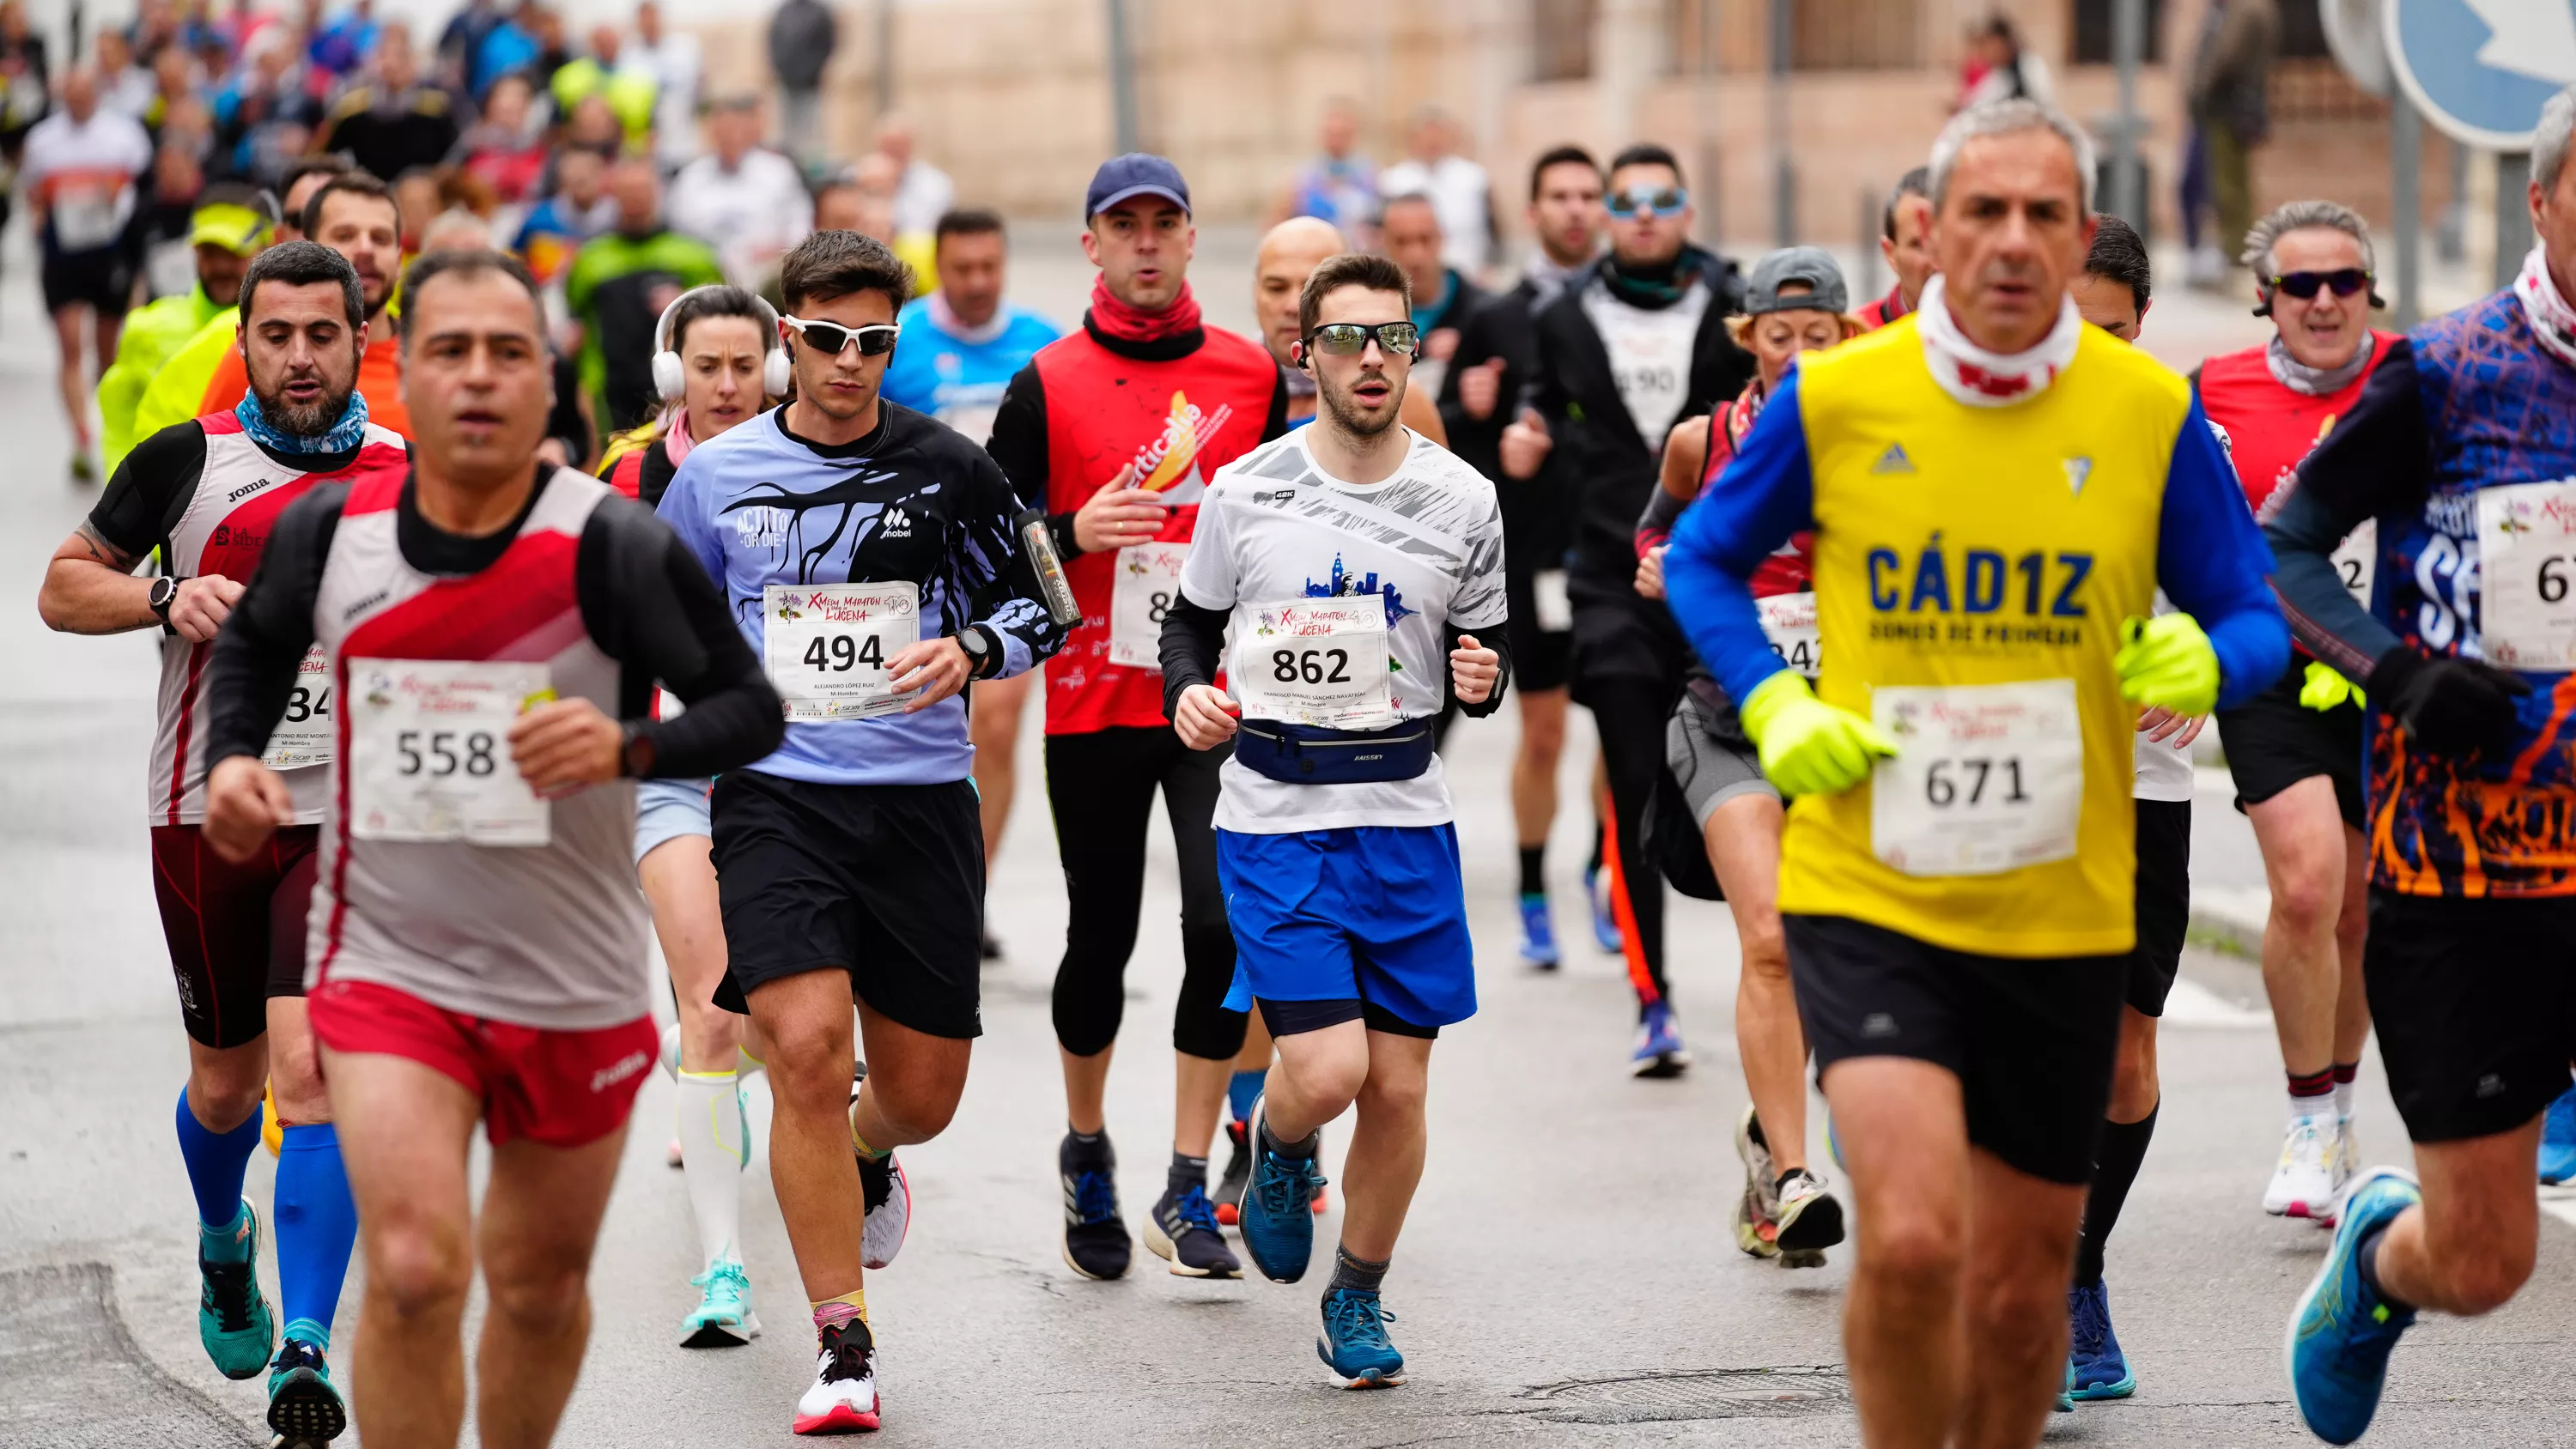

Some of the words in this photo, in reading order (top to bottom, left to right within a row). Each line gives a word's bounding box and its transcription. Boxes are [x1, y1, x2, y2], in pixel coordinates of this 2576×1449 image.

[884, 529, 912, 538] mobel
[825, 608, 872, 621] LUCENA
[804, 634, 884, 671] 494
[1273, 648, 1351, 684] 862
[398, 731, 495, 776] 558
[1925, 756, 2032, 807] 671
